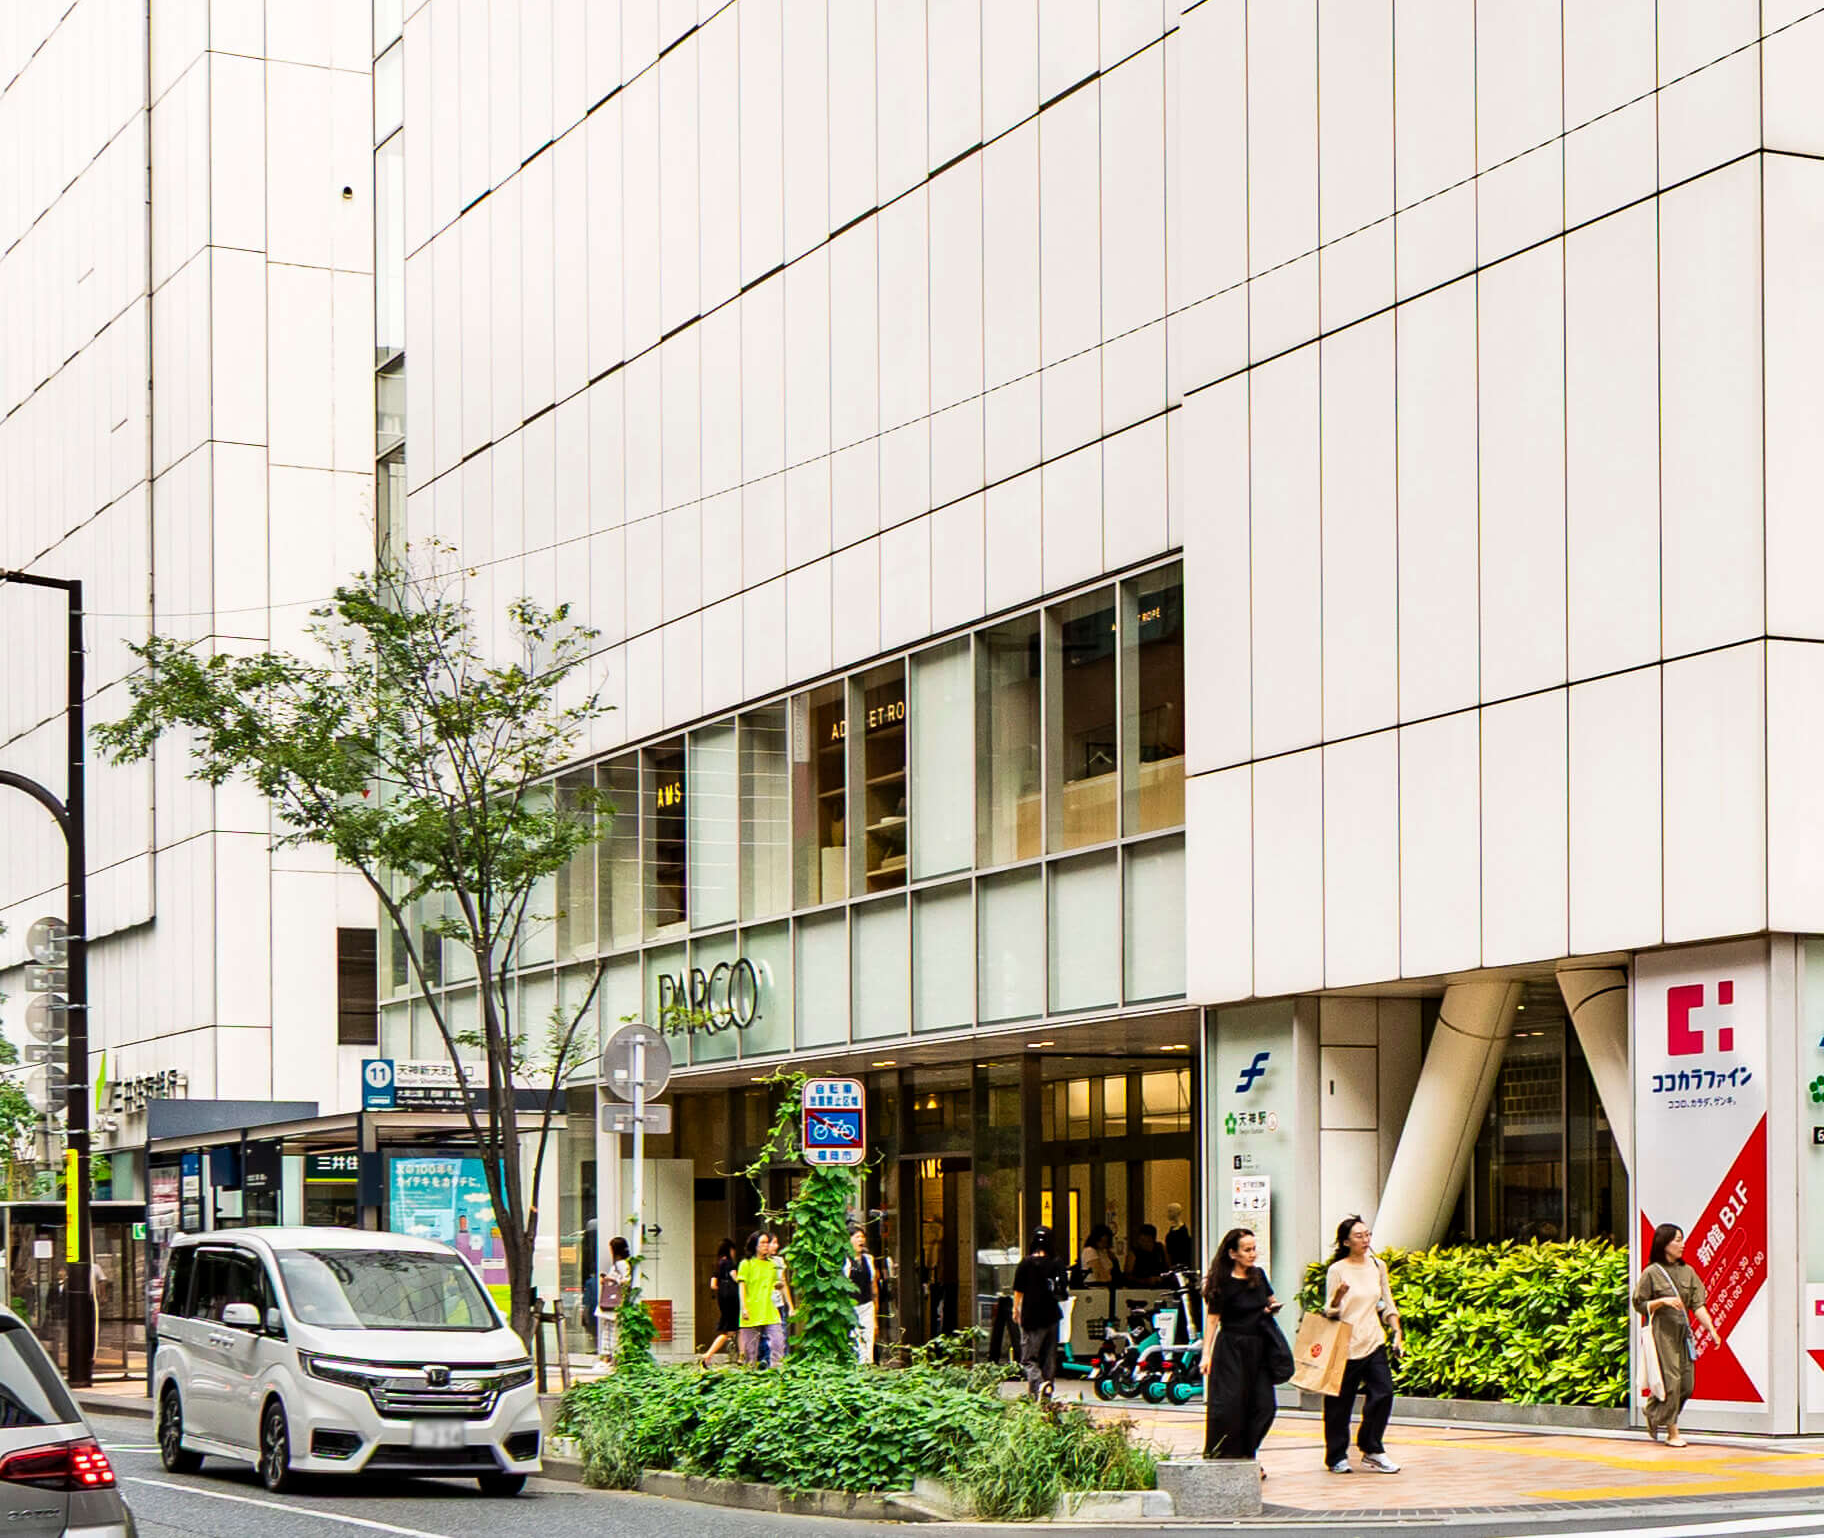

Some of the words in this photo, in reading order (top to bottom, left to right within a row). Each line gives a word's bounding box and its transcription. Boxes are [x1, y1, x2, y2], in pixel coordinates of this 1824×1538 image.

[657, 958, 758, 1036] PARCO
[370, 1068, 386, 1081] 11
[396, 1064, 474, 1078] 天神新天町口
[1652, 1066, 1753, 1094] ココカラファイン
[1696, 1224, 1726, 1267] 新館
[1719, 1180, 1749, 1230] B1F
